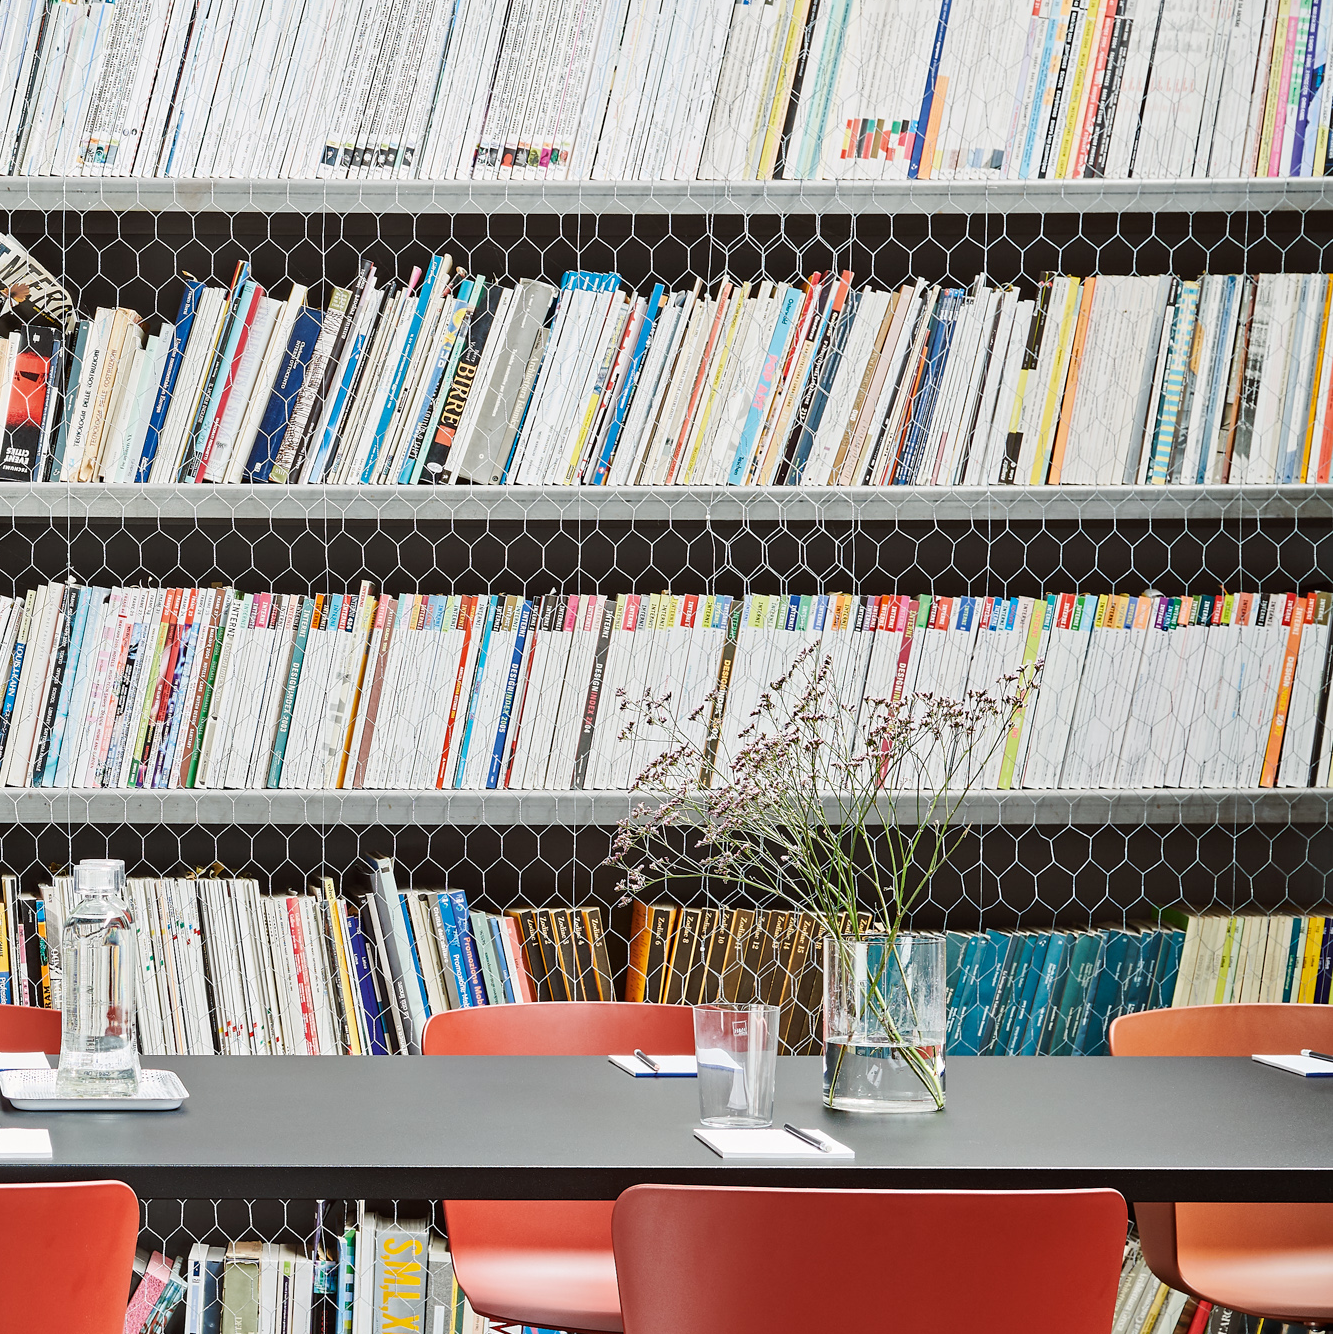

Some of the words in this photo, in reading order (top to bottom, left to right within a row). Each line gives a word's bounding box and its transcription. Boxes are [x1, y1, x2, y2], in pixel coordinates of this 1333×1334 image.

[759, 353, 779, 387] POP
[441, 361, 478, 428] BIRRE
[226, 601, 241, 638] INTERNI
[298, 609, 311, 638] INTERNI
[517, 610, 530, 638] INTERNI
[601, 610, 613, 639] INTERNI
[1291, 606, 1303, 636] INTERNI
[586, 662, 604, 715] DESIGNINDEX
[279, 715, 289, 733] 2003
[498, 716, 509, 734] 2005
[462, 936, 480, 985] Promozione
